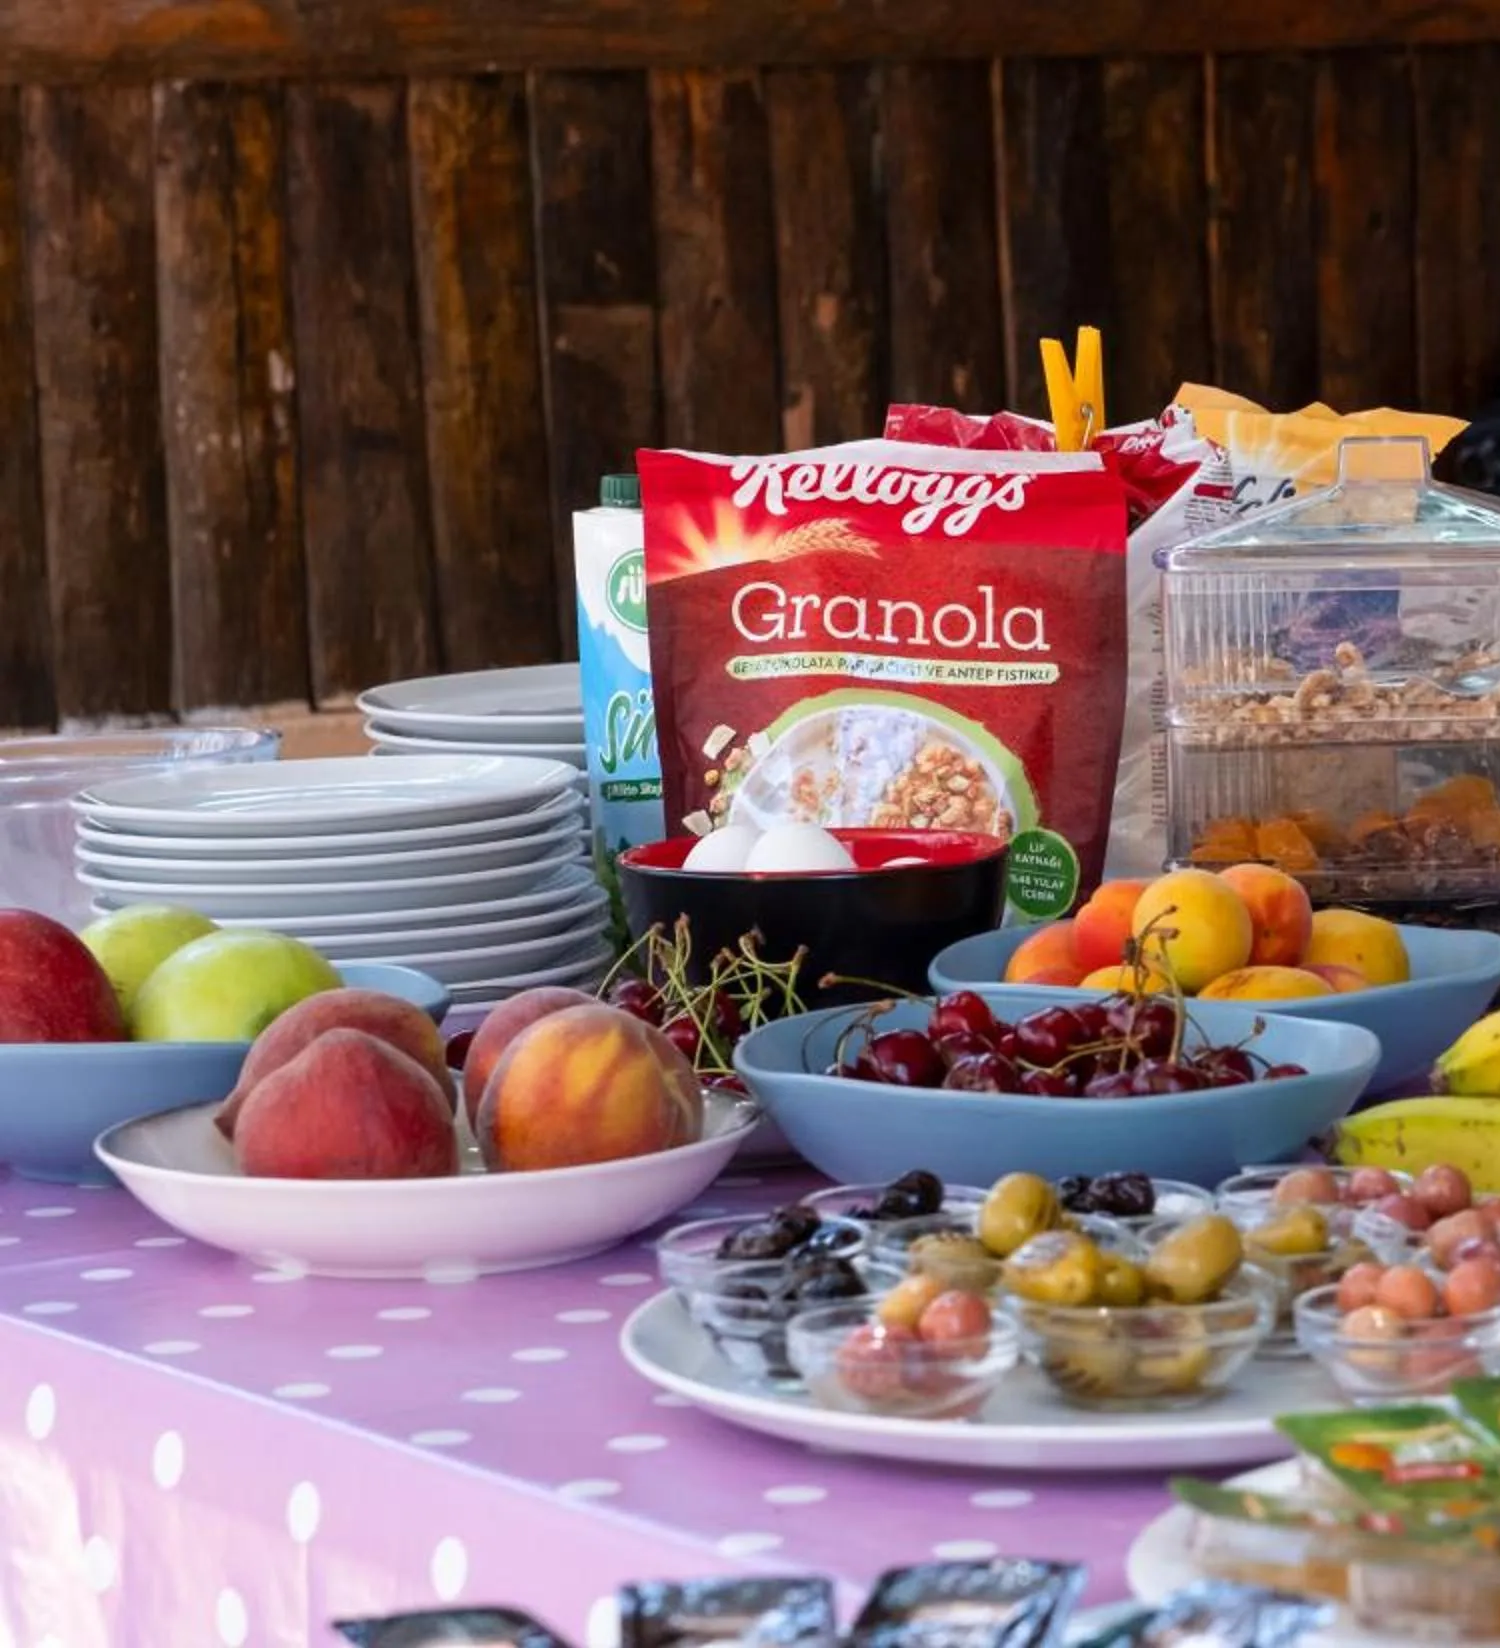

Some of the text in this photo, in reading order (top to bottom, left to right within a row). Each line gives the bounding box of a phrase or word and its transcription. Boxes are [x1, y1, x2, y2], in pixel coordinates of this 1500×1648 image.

[731, 581, 1051, 650] Granola
[925, 663, 944, 677] VE
[947, 666, 993, 681] ANTEP
